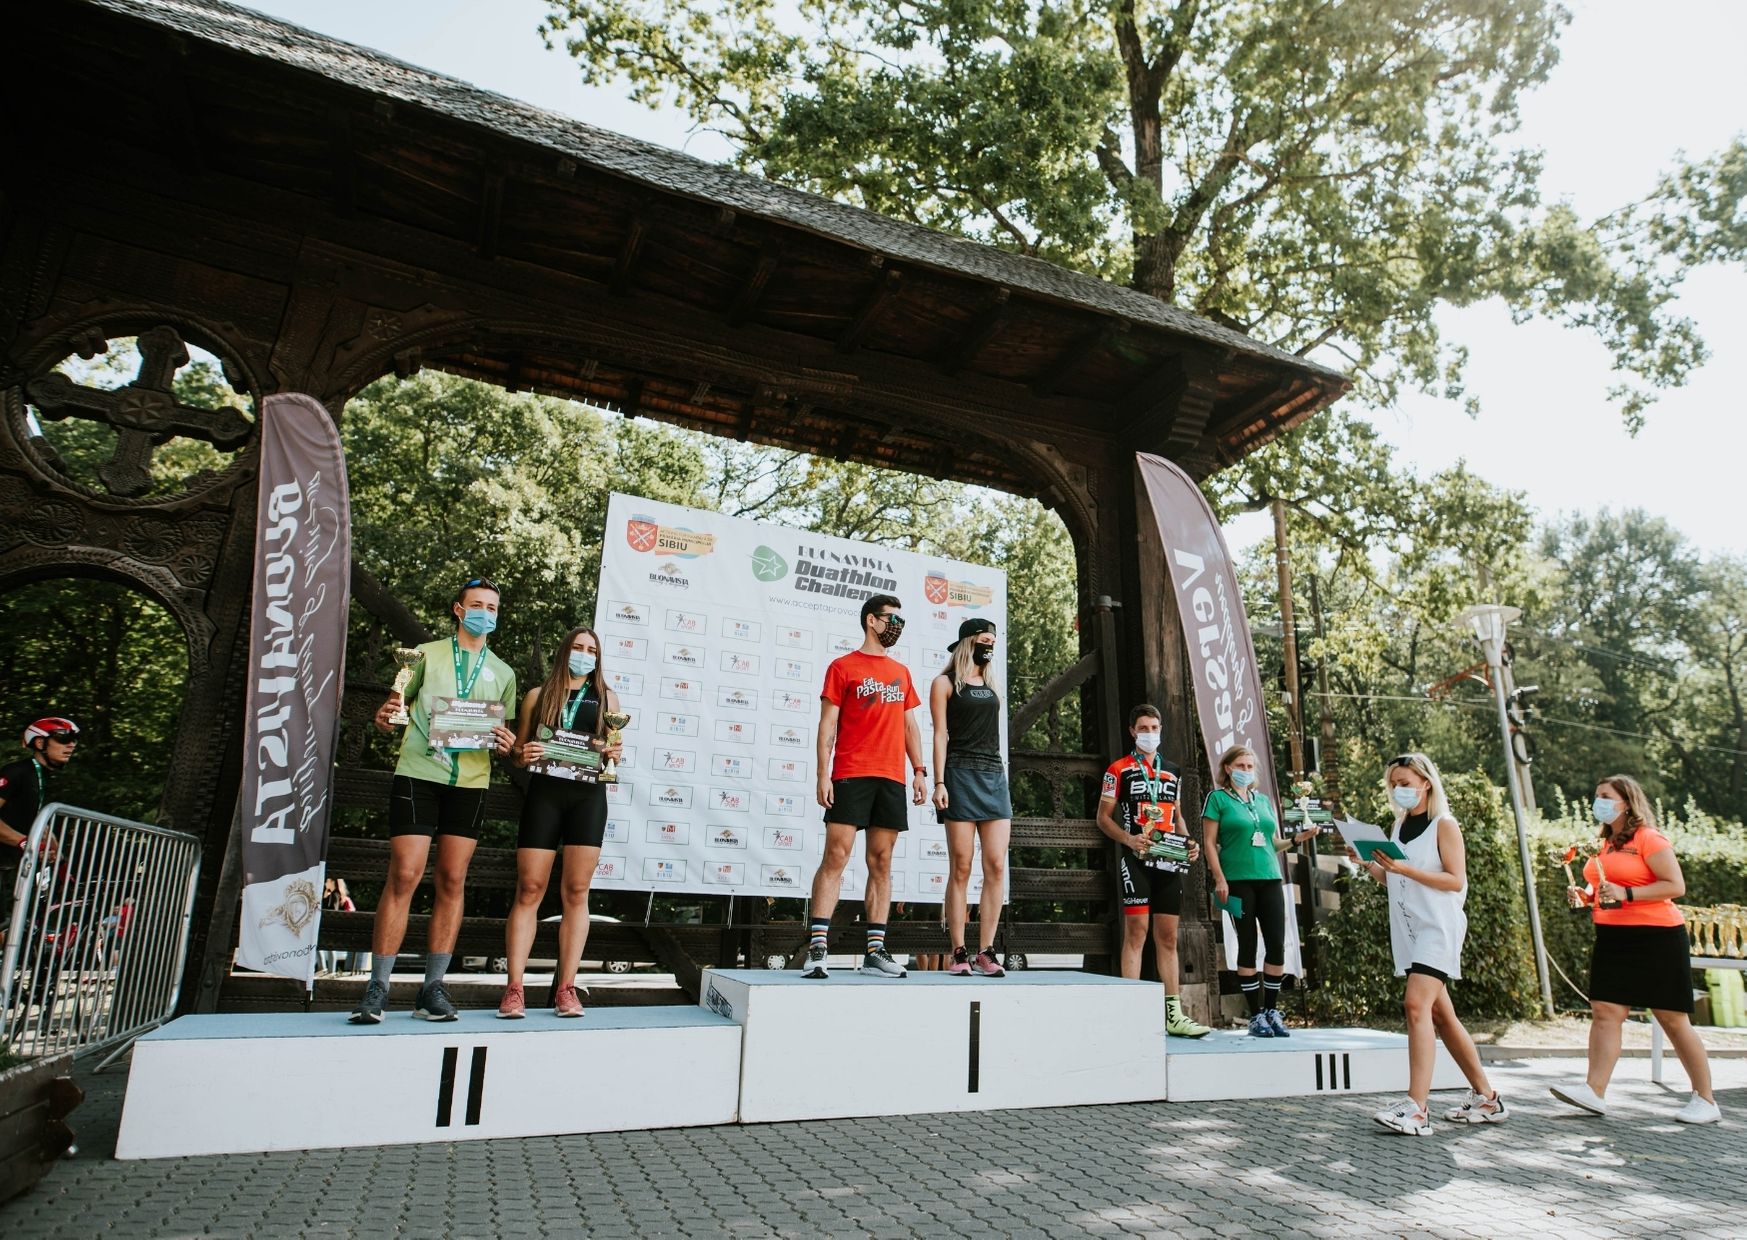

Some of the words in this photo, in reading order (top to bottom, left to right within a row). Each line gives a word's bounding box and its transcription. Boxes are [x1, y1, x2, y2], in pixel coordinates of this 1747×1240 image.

[658, 538, 688, 551] SIBIU
[798, 545, 894, 574] BUONAVISTA
[795, 559, 897, 592] Duathlon
[795, 576, 885, 602] Challen
[949, 592, 972, 601] SIBIU
[863, 677, 875, 688] Eat
[886, 684, 900, 694] Run
[881, 690, 905, 704] Fasta
[598, 863, 614, 871] CAB
